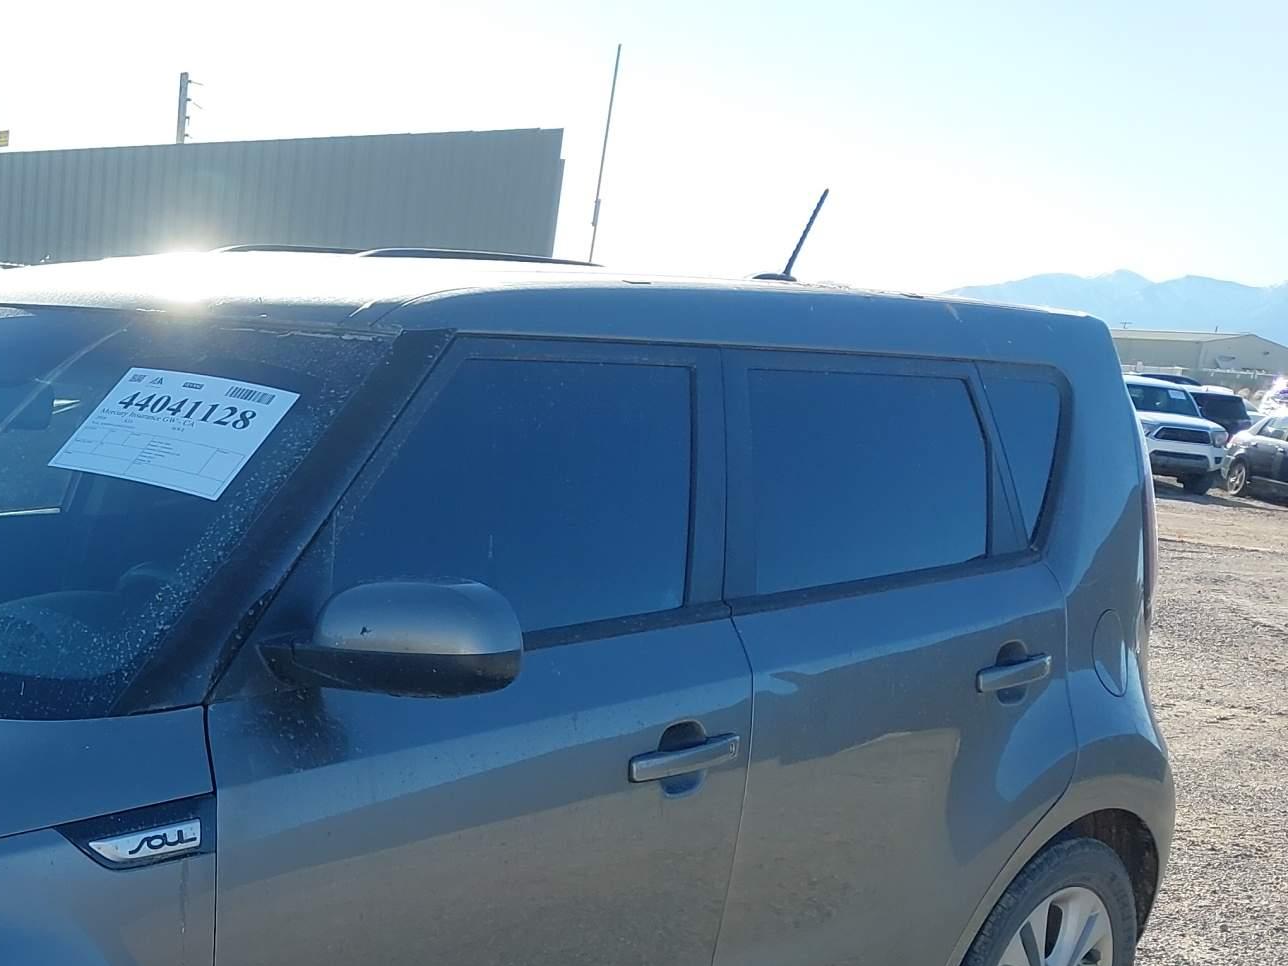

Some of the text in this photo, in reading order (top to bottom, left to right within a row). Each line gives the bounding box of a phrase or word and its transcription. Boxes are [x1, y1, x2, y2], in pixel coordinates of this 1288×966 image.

[102, 407, 128, 418] Mercury
[118, 391, 257, 430] 44041128
[128, 829, 198, 855] SOUL
